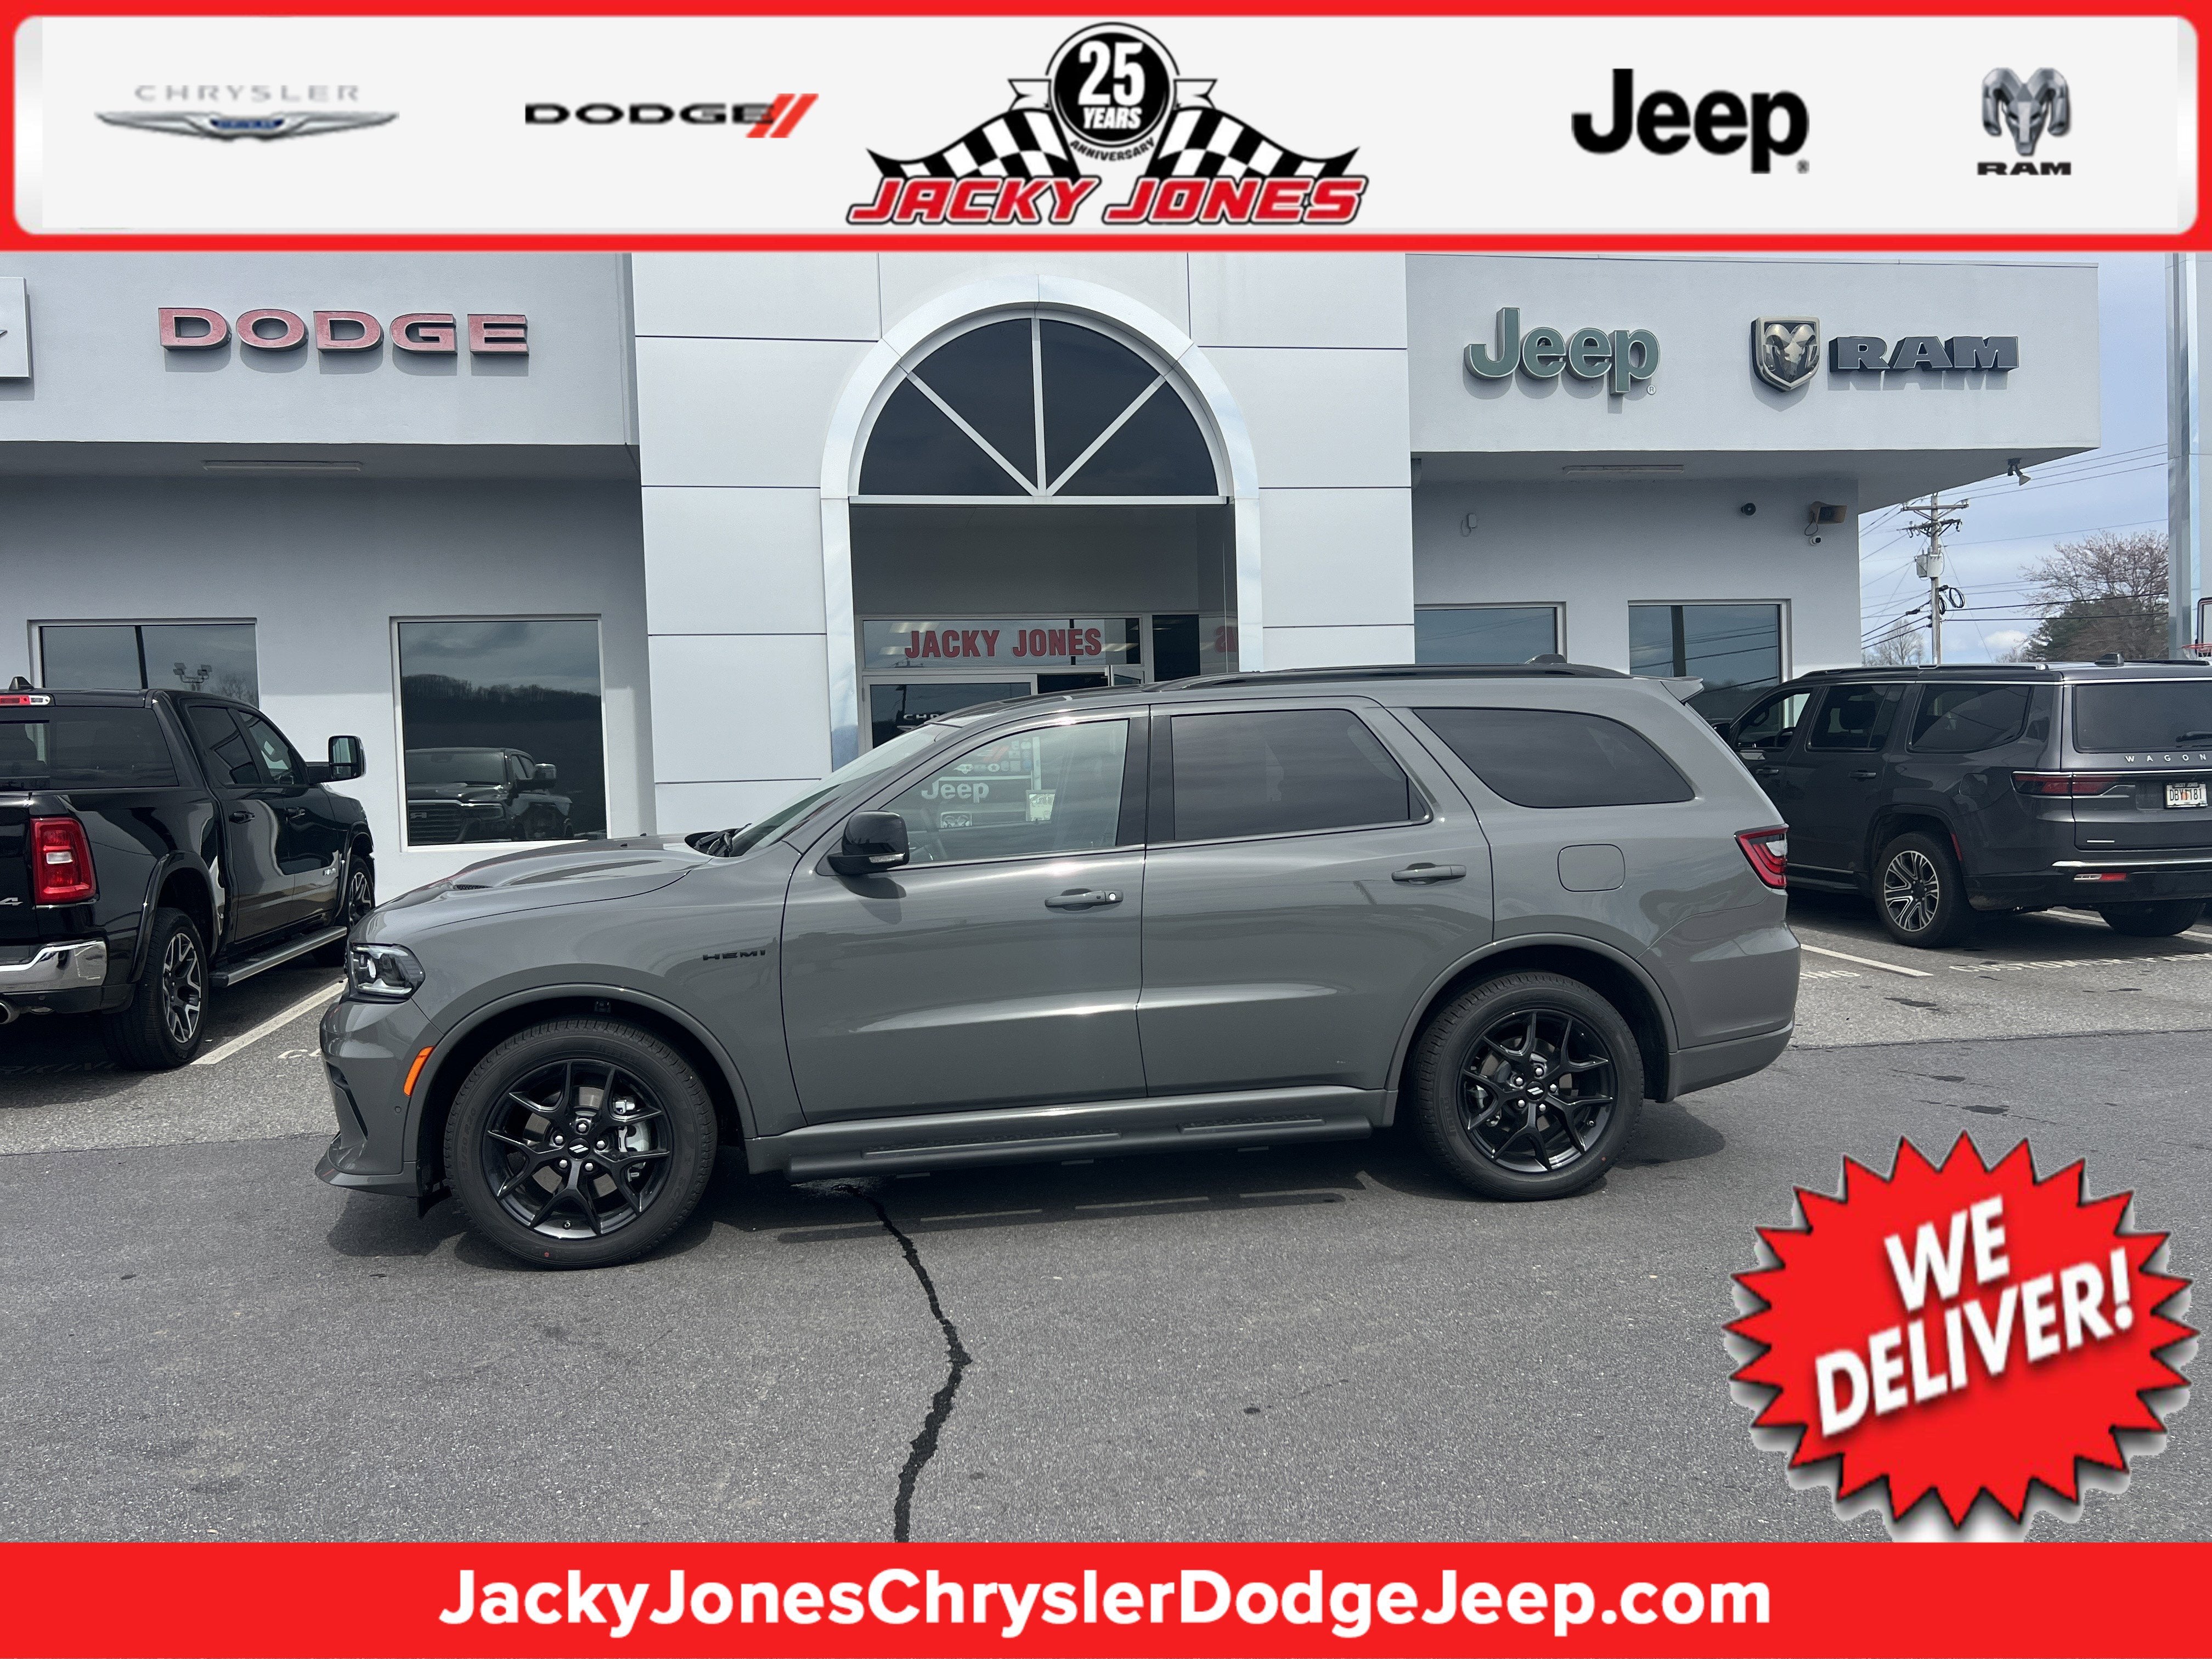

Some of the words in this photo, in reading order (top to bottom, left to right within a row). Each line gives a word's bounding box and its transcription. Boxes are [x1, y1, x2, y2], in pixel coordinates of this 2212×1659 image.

[158, 307, 529, 356] DODGE
[1464, 307, 1660, 395] Jeep
[1829, 336, 2019, 372] RAM
[905, 630, 1000, 658] JACKY
[1012, 628, 1102, 657] JONES
[2125, 754, 2207, 763] WAGON
[922, 782, 989, 804] Jeep
[703, 950, 766, 961] HEMI
